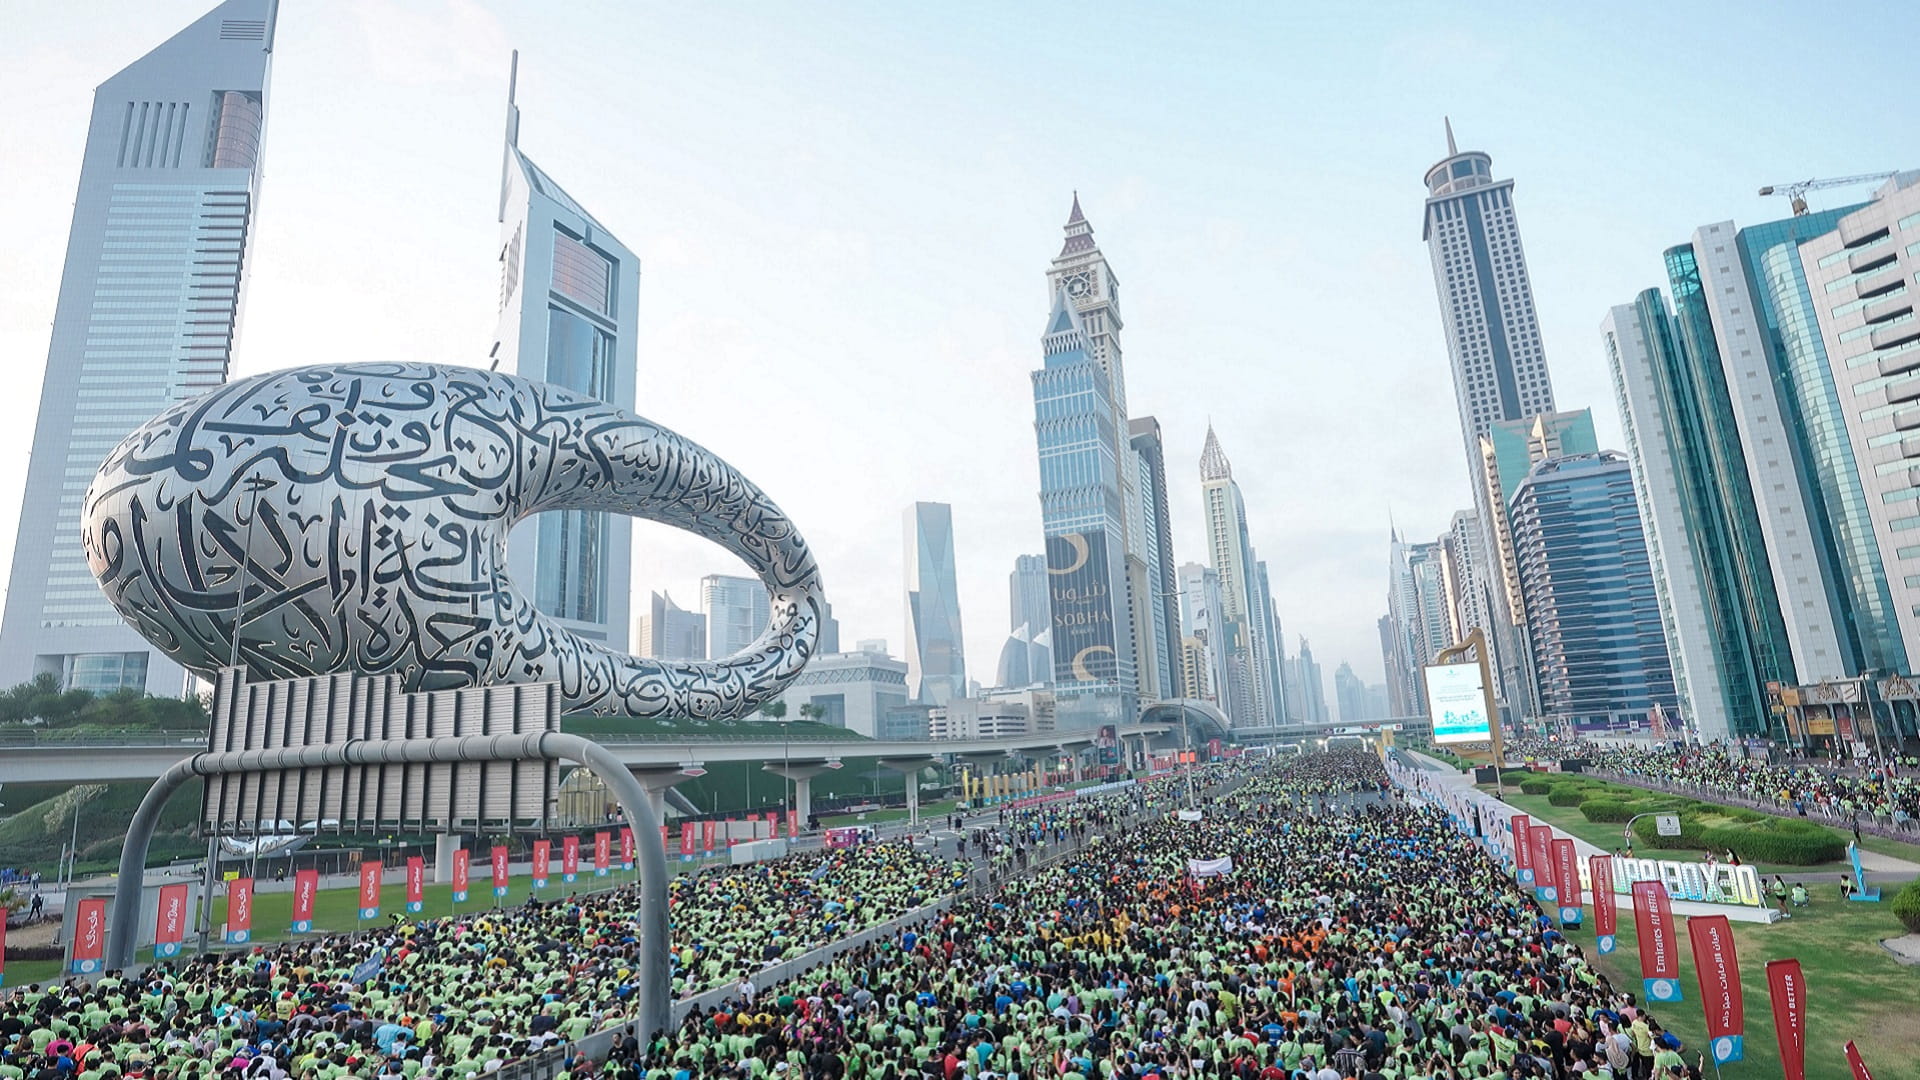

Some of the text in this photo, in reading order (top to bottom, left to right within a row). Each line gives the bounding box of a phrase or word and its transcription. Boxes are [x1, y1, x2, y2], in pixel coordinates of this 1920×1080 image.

[1054, 610, 1110, 627] SOBHA
[1647, 890, 1658, 913] BETTER
[1651, 914, 1661, 926] FLY
[1655, 928, 1667, 973] Emirates
[1709, 927, 1722, 951] طيران
[1784, 974, 1796, 1009] BETTER
